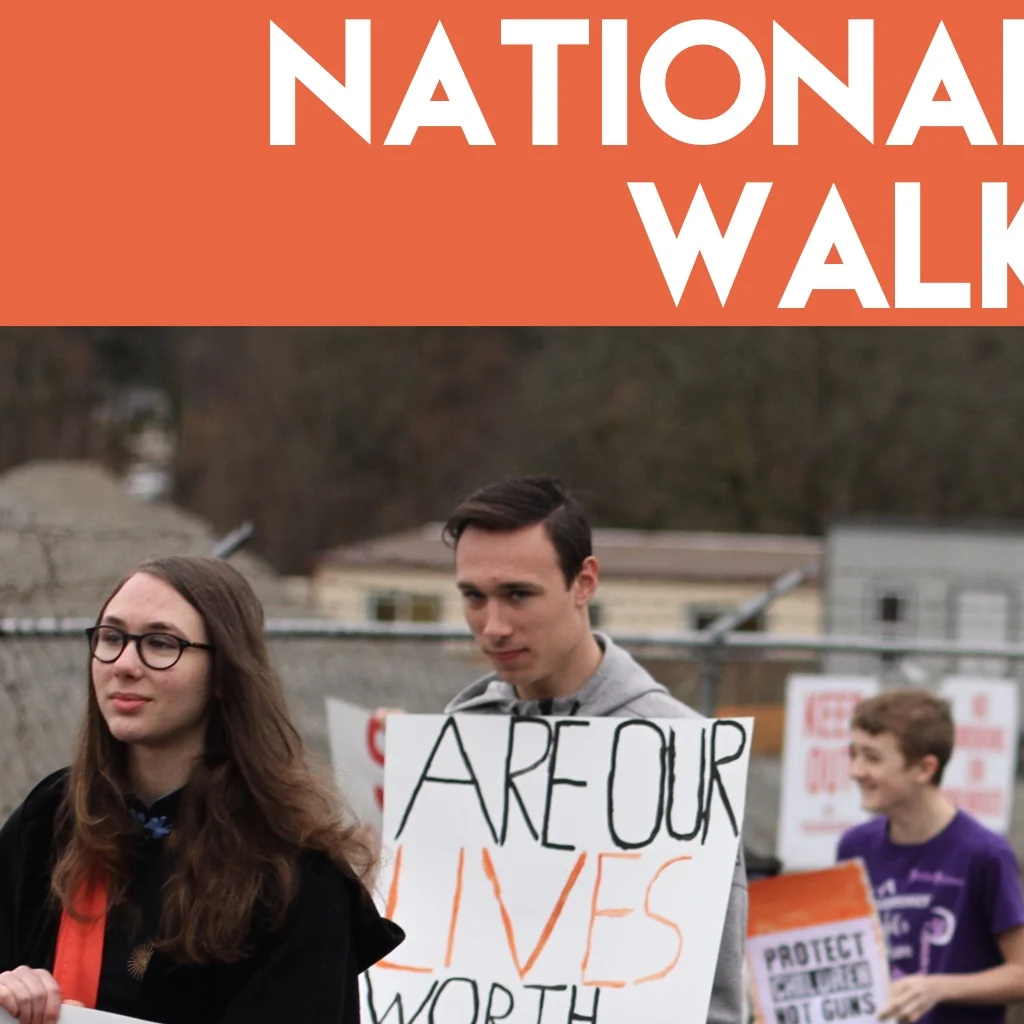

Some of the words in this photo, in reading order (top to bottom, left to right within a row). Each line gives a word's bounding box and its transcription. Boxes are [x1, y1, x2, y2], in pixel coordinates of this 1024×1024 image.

[395, 716, 590, 850] ARE
[607, 718, 747, 850] OUR
[377, 848, 694, 988] LIVES
[763, 932, 865, 971] PROTECT
[821, 993, 877, 1021] GUNS
